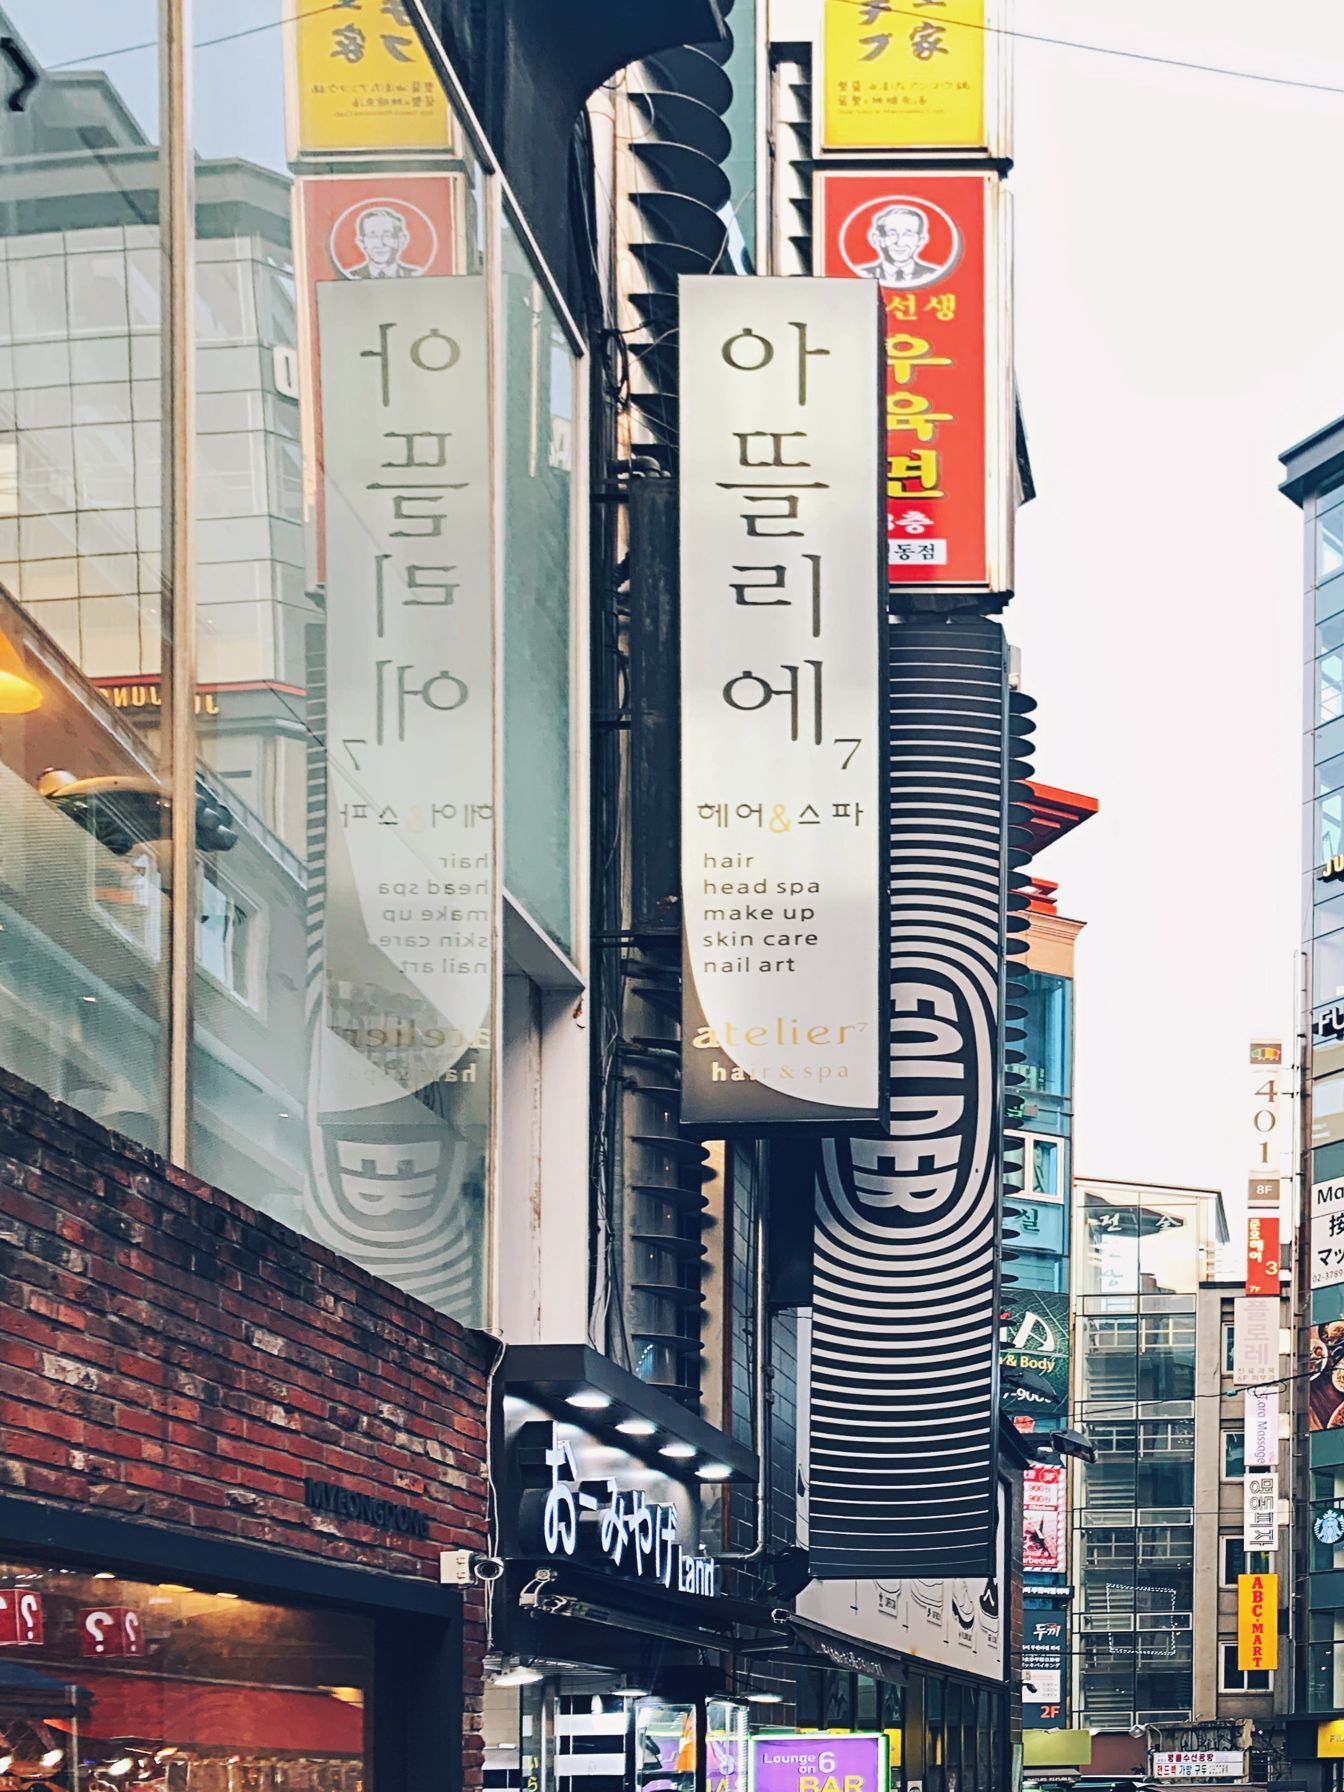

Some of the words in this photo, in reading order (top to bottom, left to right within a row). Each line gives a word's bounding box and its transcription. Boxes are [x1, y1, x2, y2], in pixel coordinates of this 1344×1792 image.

[715, 321, 830, 745] 아뜰리에
[703, 851, 754, 869] hair
[703, 879, 768, 895] head
[776, 881, 820, 896] spa
[704, 905, 774, 921] make
[782, 908, 815, 922] up
[703, 931, 754, 947] skin
[763, 934, 819, 946] care
[704, 957, 751, 973] nail
[758, 957, 796, 972] art
[803, 1063, 849, 1083] spa
[1254, 1079, 1278, 1164] 401
[1256, 1184, 1273, 1195] 8F
[1248, 1285, 1262, 1293] 7F
[1020, 1355, 1056, 1372] Body
[1254, 1421, 1268, 1464] Massage
[1040, 1706, 1061, 1719] 2F
[763, 1752, 816, 1767] Lounge
[818, 1751, 836, 1773] 6
[798, 1764, 816, 1774] on
[799, 1775, 864, 1792] BAR
